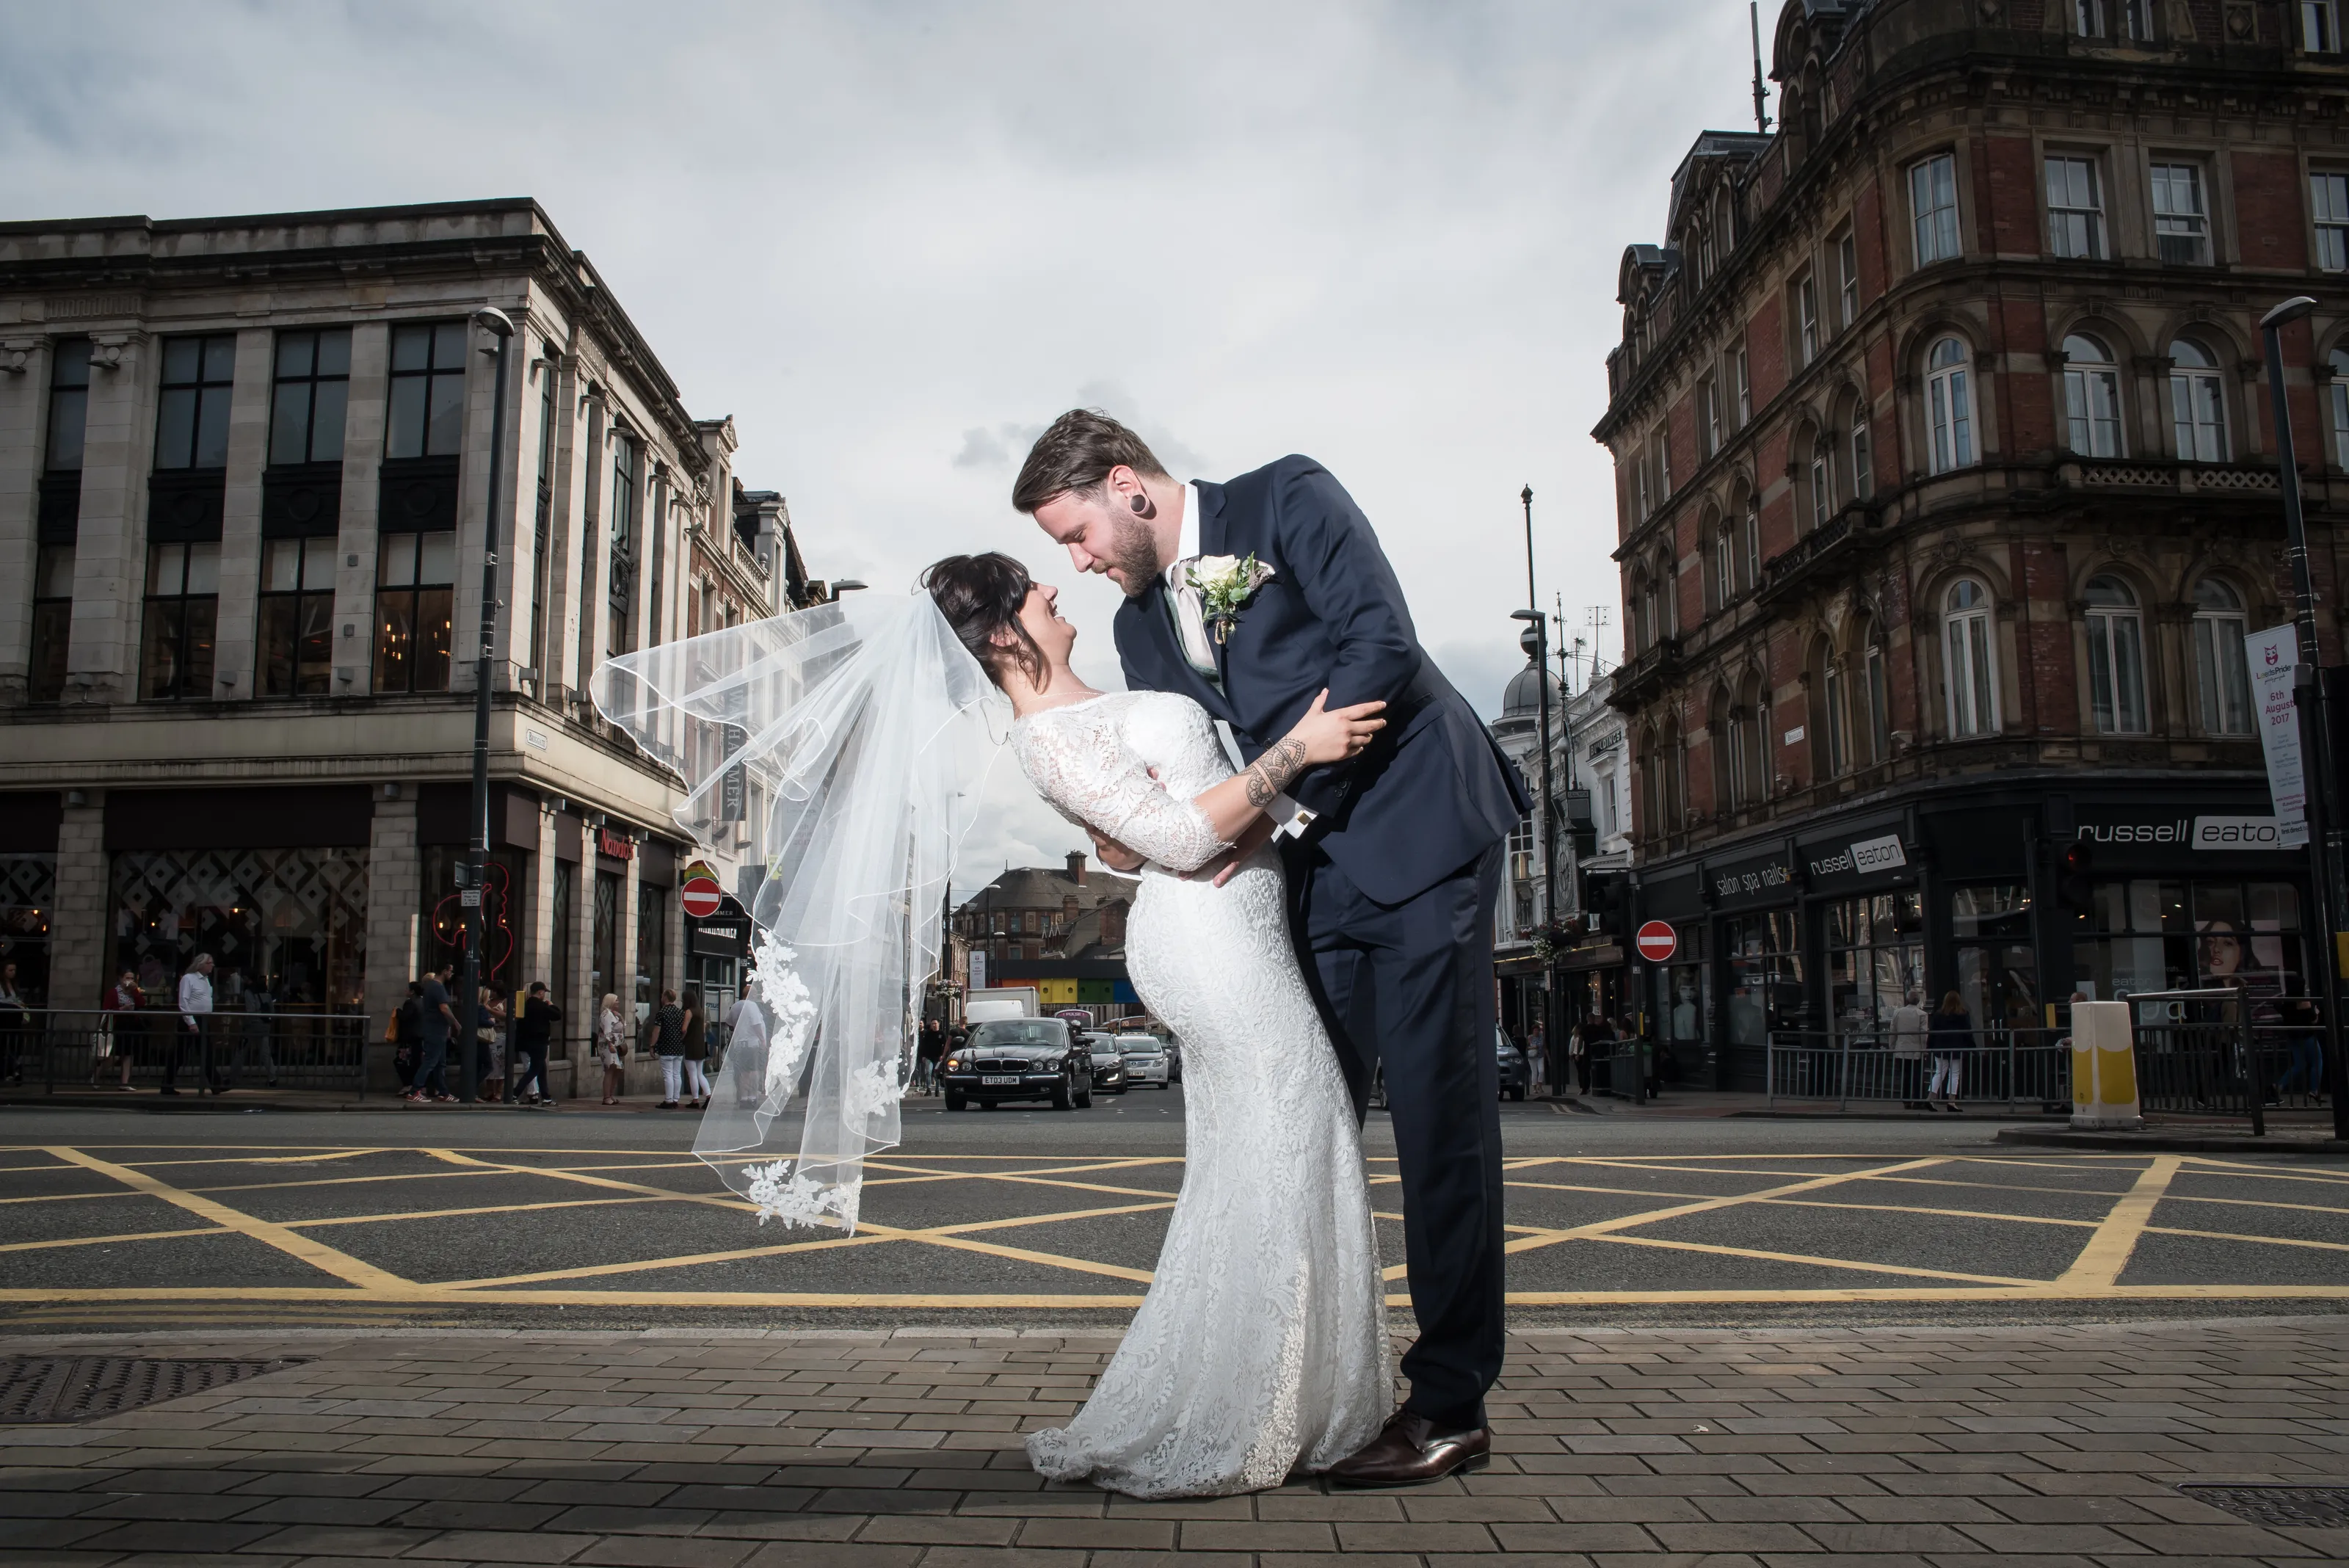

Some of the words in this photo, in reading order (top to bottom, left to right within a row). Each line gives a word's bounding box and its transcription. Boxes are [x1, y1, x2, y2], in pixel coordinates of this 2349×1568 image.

[2256, 664, 2292, 680] LeedsPride
[2270, 690, 2284, 702] 6th
[2265, 699, 2295, 714] August
[2270, 713, 2290, 726] 2017
[1590, 731, 1622, 755] BUILDINGS
[2078, 819, 2188, 842] russell
[2202, 822, 2280, 842] eato
[600, 828, 633, 860] Nando's
[1810, 849, 1854, 875] russell
[1856, 843, 1900, 866] eaton
[1716, 874, 1740, 896] salon
[1742, 871, 1760, 895] spa
[1762, 862, 1786, 887] nails
[2111, 976, 2154, 987] eaton
